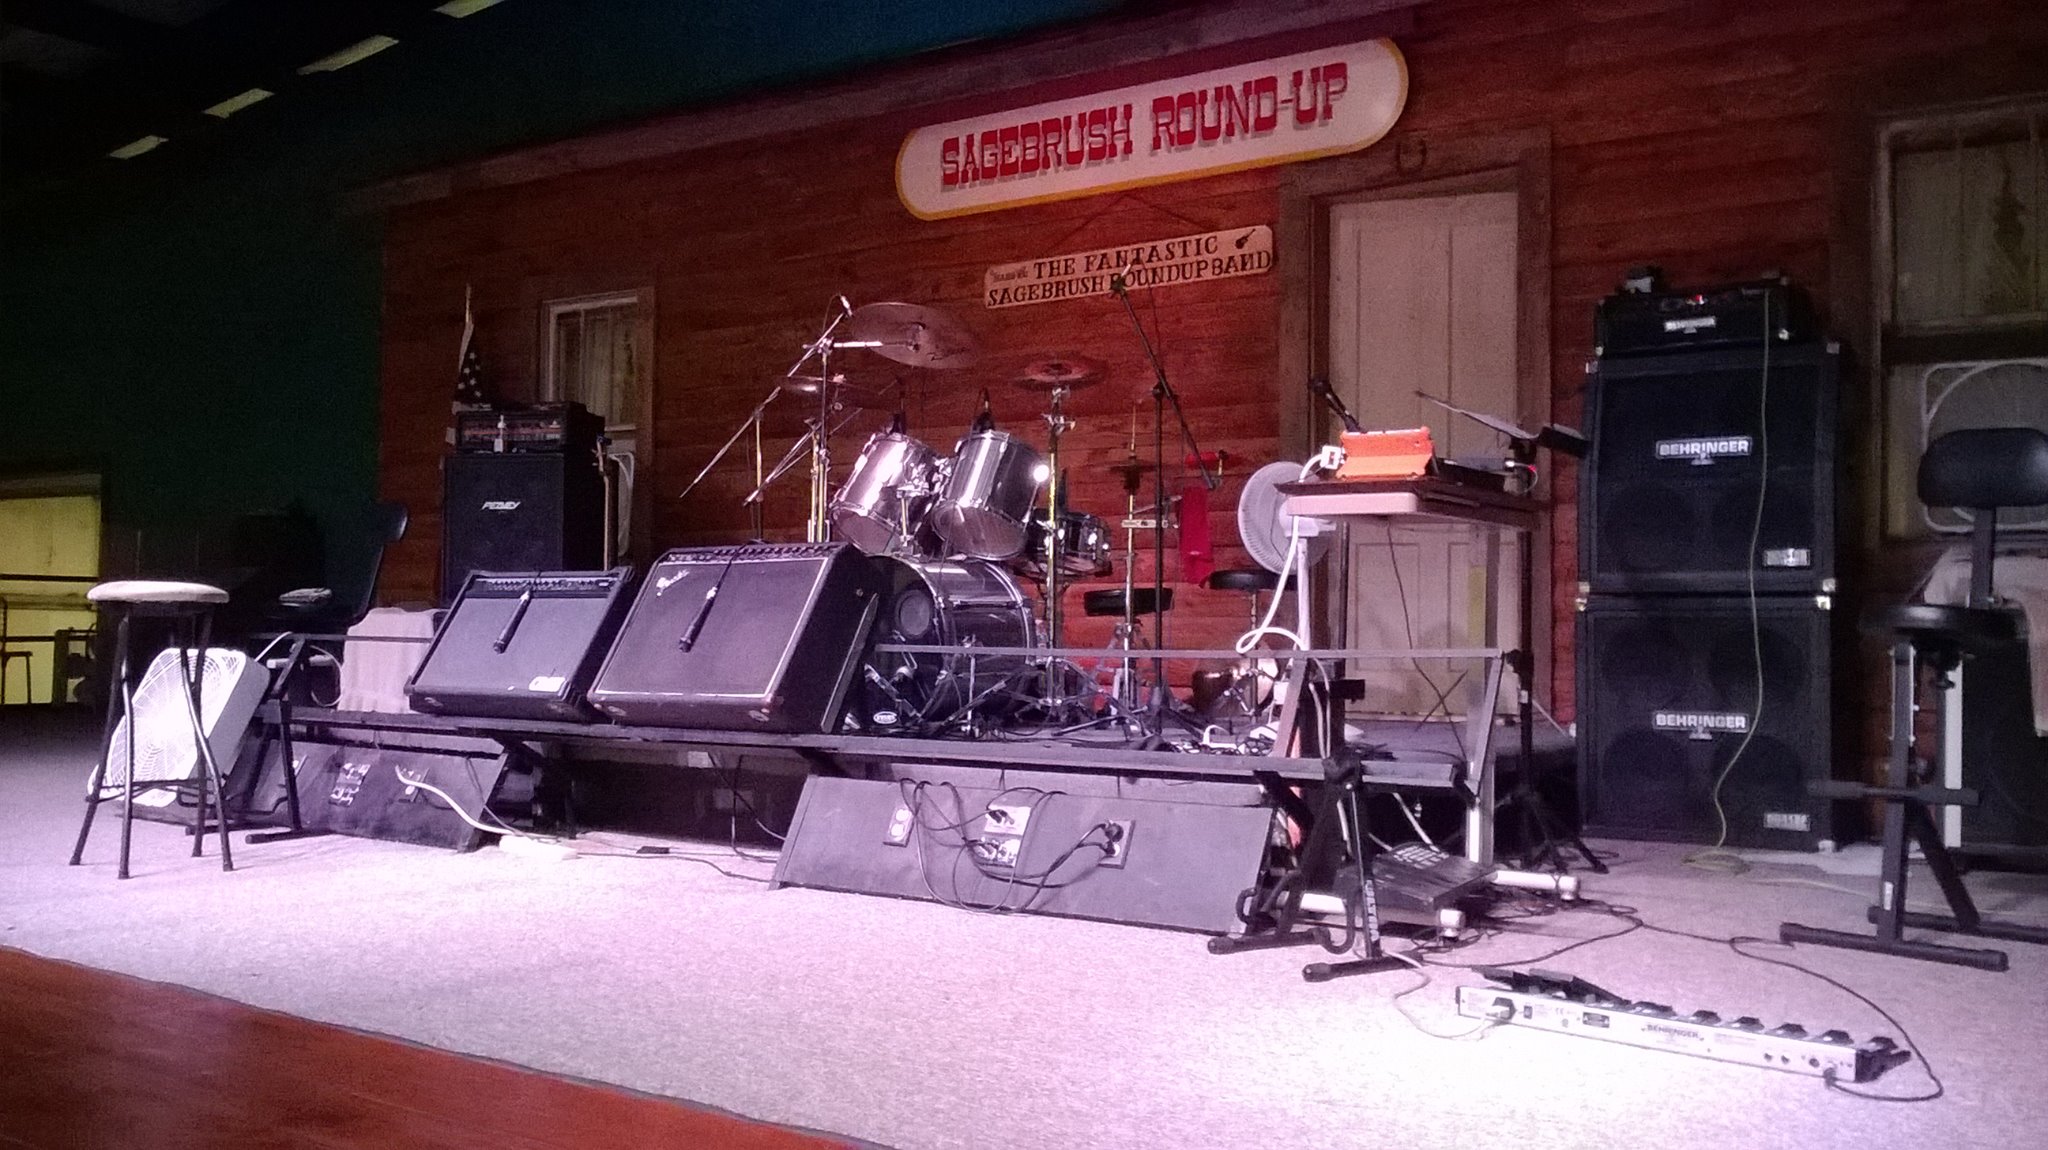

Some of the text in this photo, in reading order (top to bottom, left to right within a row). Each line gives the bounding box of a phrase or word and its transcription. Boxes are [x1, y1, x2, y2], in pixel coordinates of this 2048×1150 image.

[943, 63, 1347, 185] SAGEBRUSH ROUND-UP
[987, 276, 1103, 307] SAGEBRUSH
[1211, 251, 1271, 276] BAND
[1033, 258, 1076, 279] THE
[1084, 236, 1218, 273] FANTASTIC
[1660, 440, 1749, 456] BEHRINGER
[1656, 713, 1746, 729] BEHRINGER
